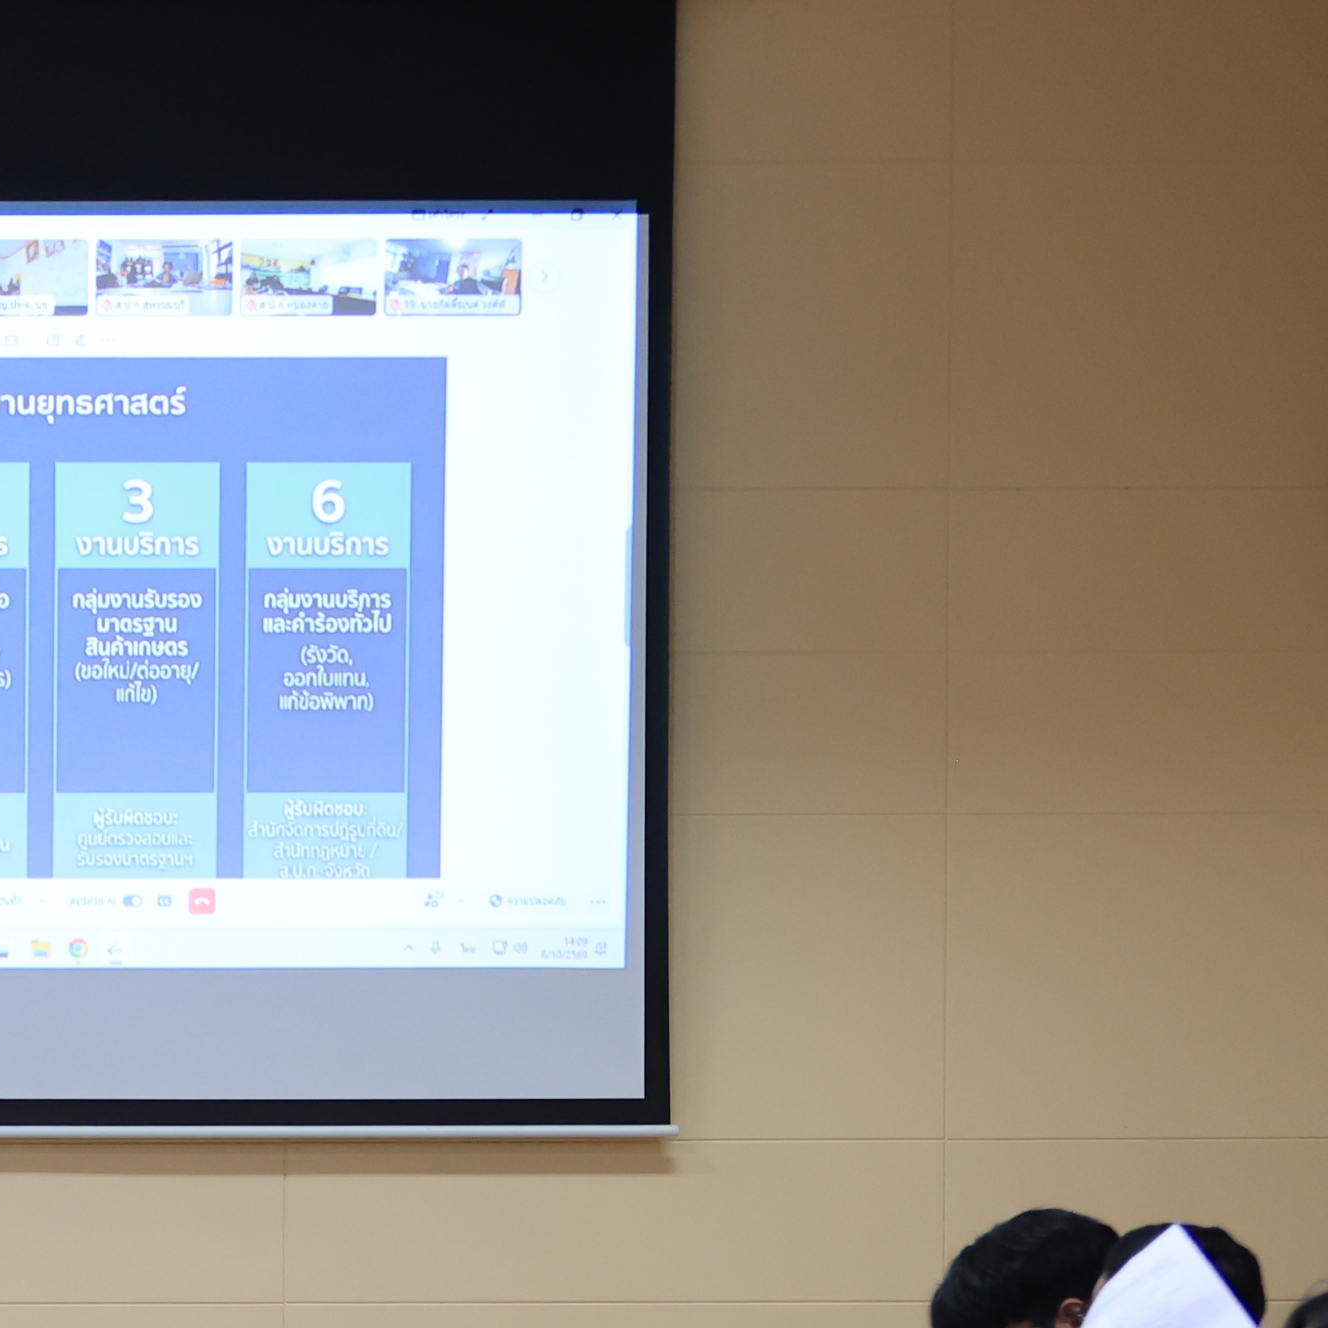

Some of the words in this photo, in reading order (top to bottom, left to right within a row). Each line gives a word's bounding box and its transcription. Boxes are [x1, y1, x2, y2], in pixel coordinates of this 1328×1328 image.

[122, 479, 154, 524] 3
[311, 479, 345, 524] 6
[75, 529, 199, 560] งานบริการ
[267, 529, 390, 560] งานบริการ
[72, 588, 202, 615] กลุ่มงานรับรอง
[264, 587, 391, 615] กลุ่มงานบริการ
[96, 615, 177, 637] มาตรฐาน
[85, 635, 189, 657] สินค้าเกษตร
